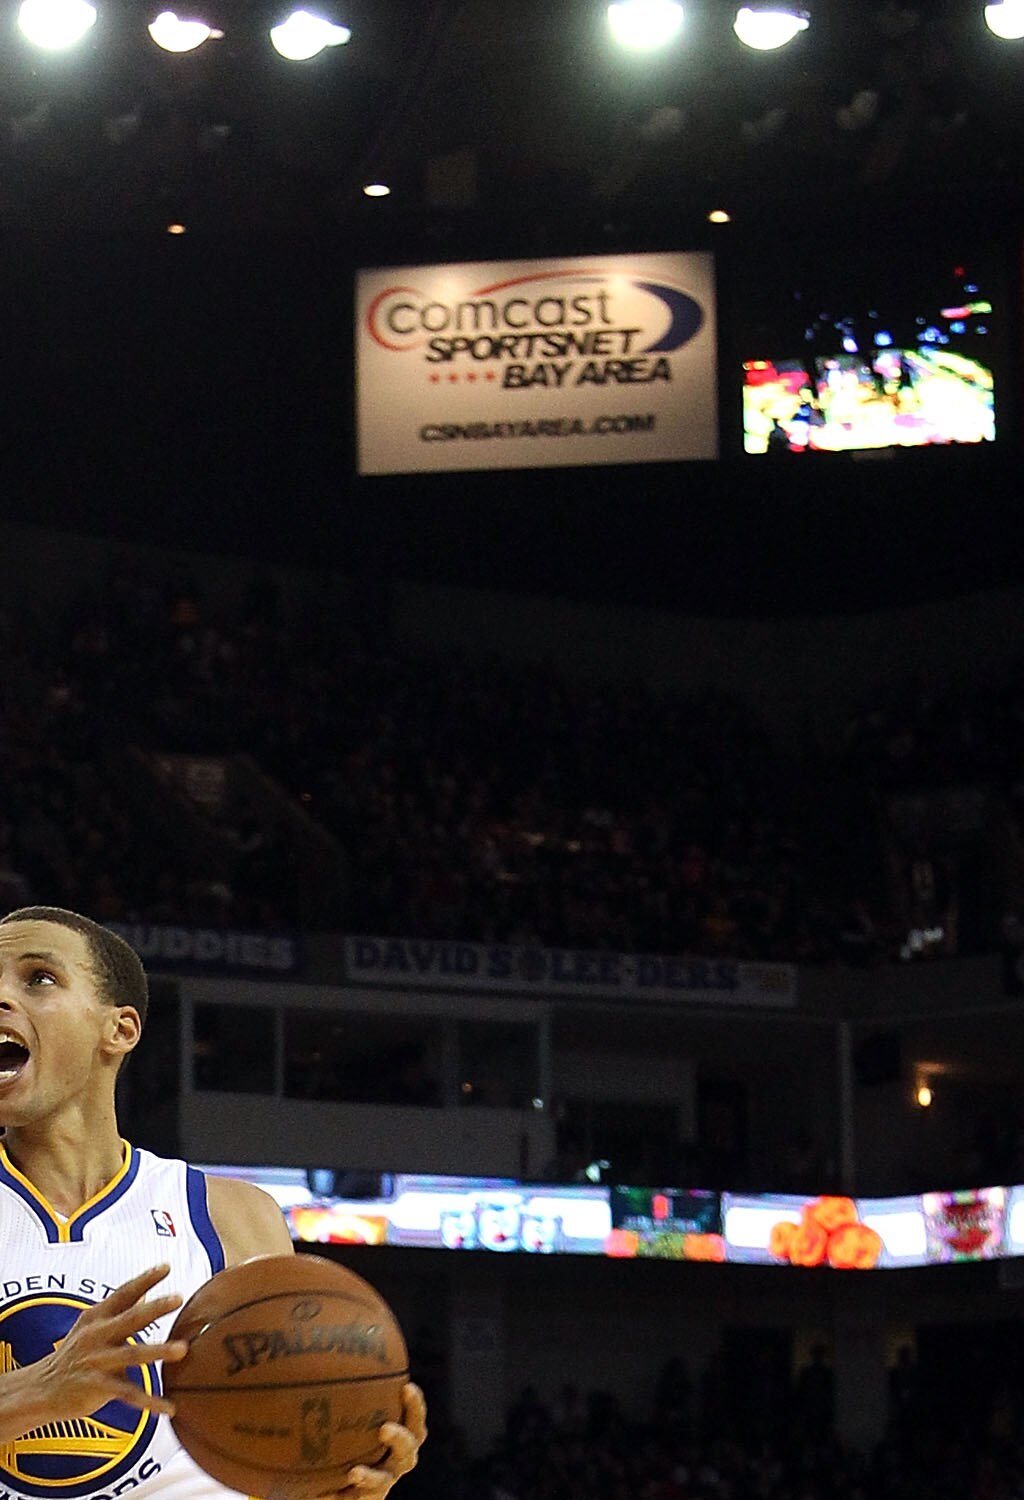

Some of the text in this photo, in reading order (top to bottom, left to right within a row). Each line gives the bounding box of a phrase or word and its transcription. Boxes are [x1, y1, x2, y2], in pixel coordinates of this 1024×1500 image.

[426, 328, 643, 363] SPORTSNET
[503, 357, 674, 390] BAY AREA
[78, 1278, 161, 1339] STE
[224, 1322, 388, 1376] SPALDING
